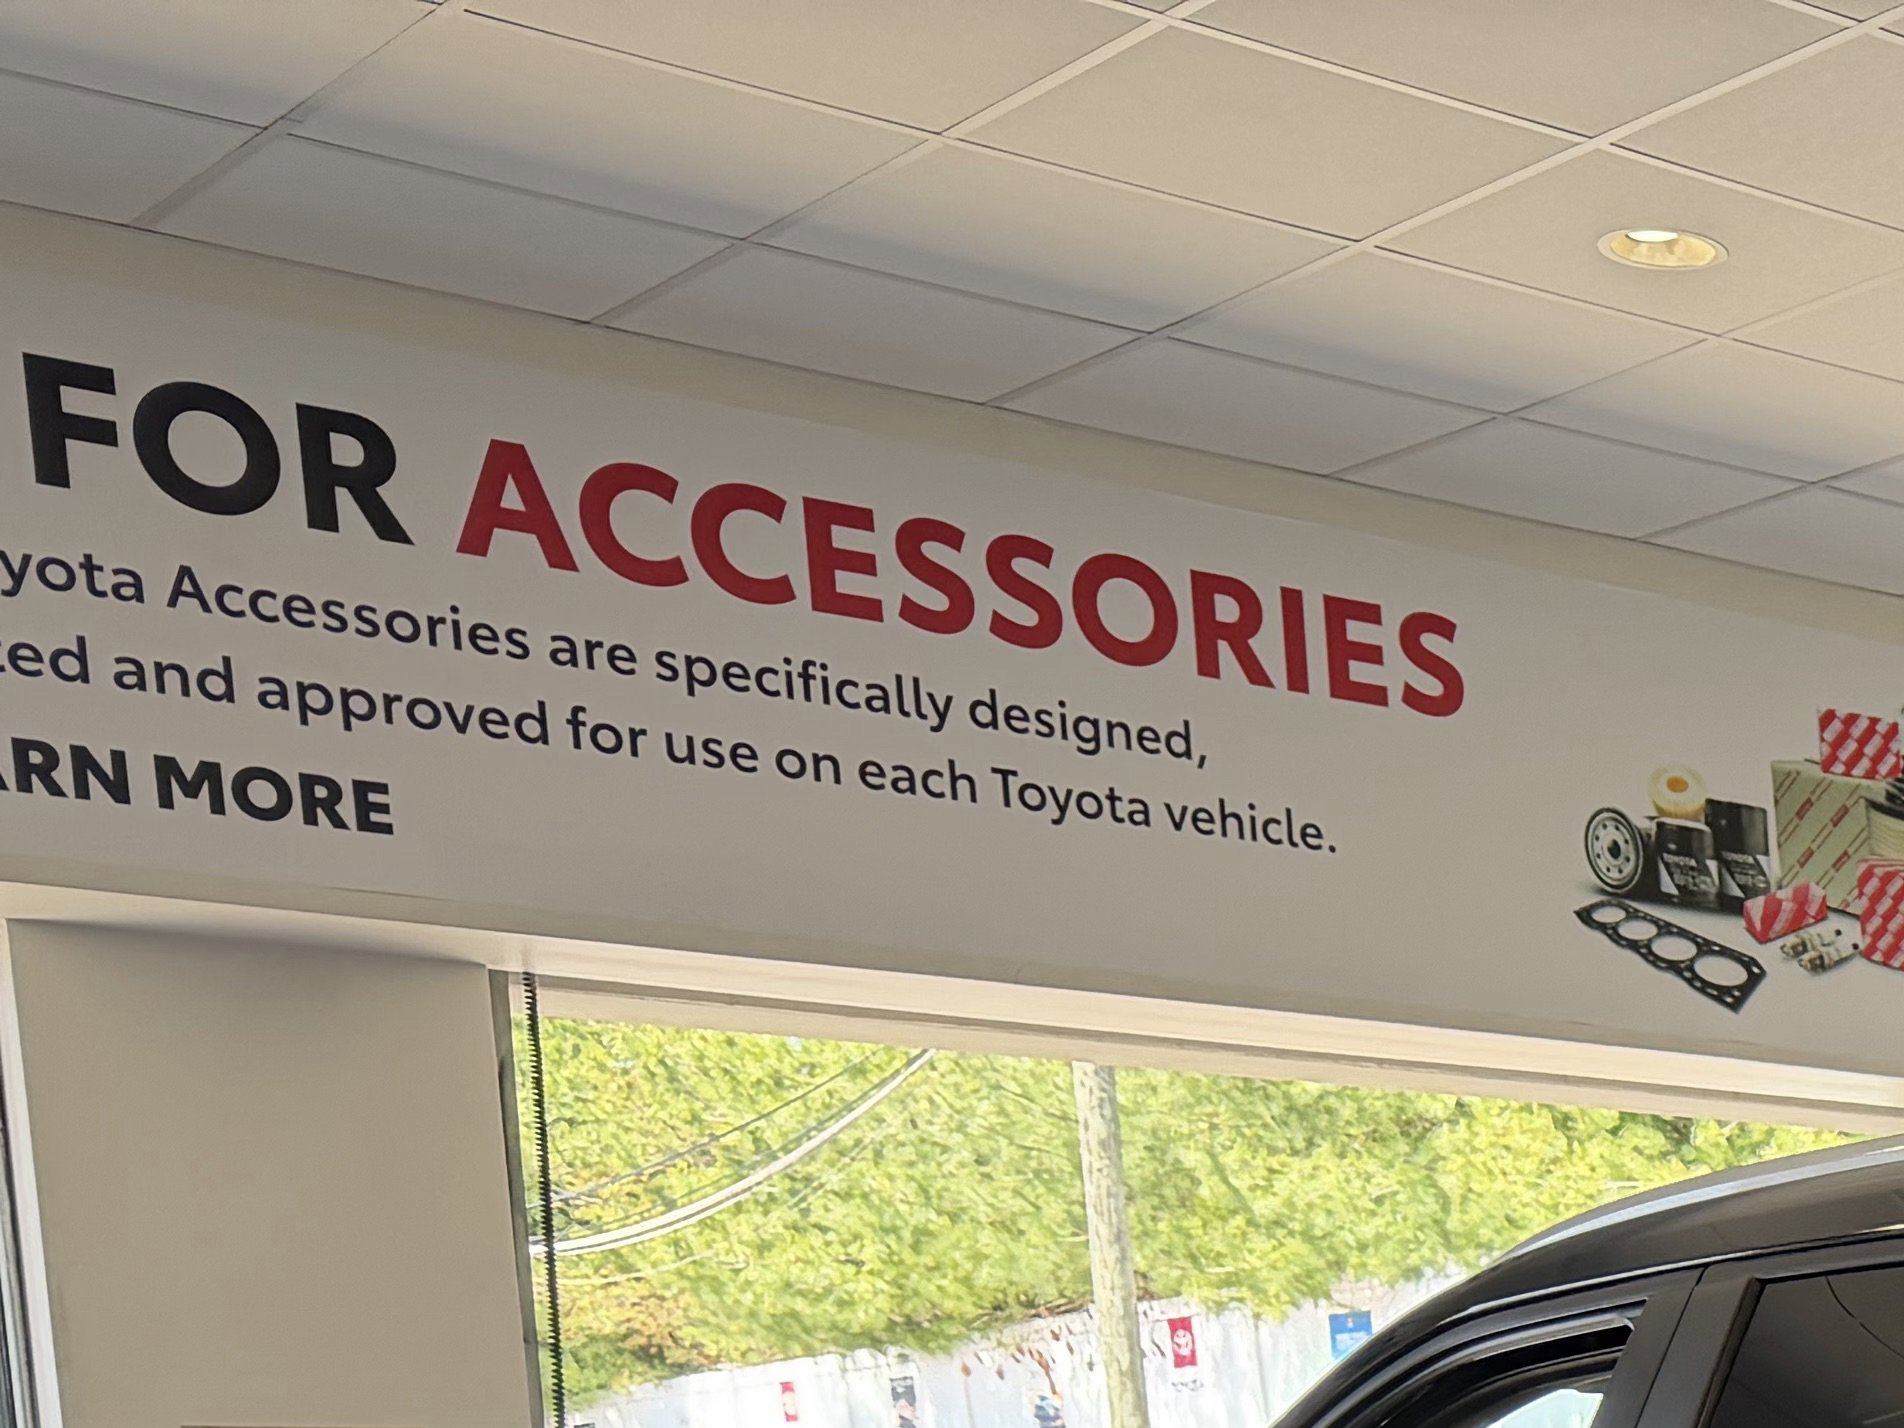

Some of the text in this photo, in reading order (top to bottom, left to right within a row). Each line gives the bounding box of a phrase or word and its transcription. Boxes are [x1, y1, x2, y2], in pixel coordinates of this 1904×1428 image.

[23, 352, 1464, 717] FOR ACCESSORIES
[114, 656, 235, 704] and
[258, 677, 549, 745] approved
[566, 705, 647, 757] for
[665, 732, 758, 773] use
[776, 749, 841, 785] on
[859, 759, 977, 803] each
[991, 767, 1151, 827] Toyota
[1164, 798, 1336, 853] vehicle.
[167, 565, 530, 660] Accessories
[549, 635, 637, 675] are
[655, 651, 953, 732] specifically
[969, 688, 1206, 769] designed,
[153, 754, 394, 835] MORE
